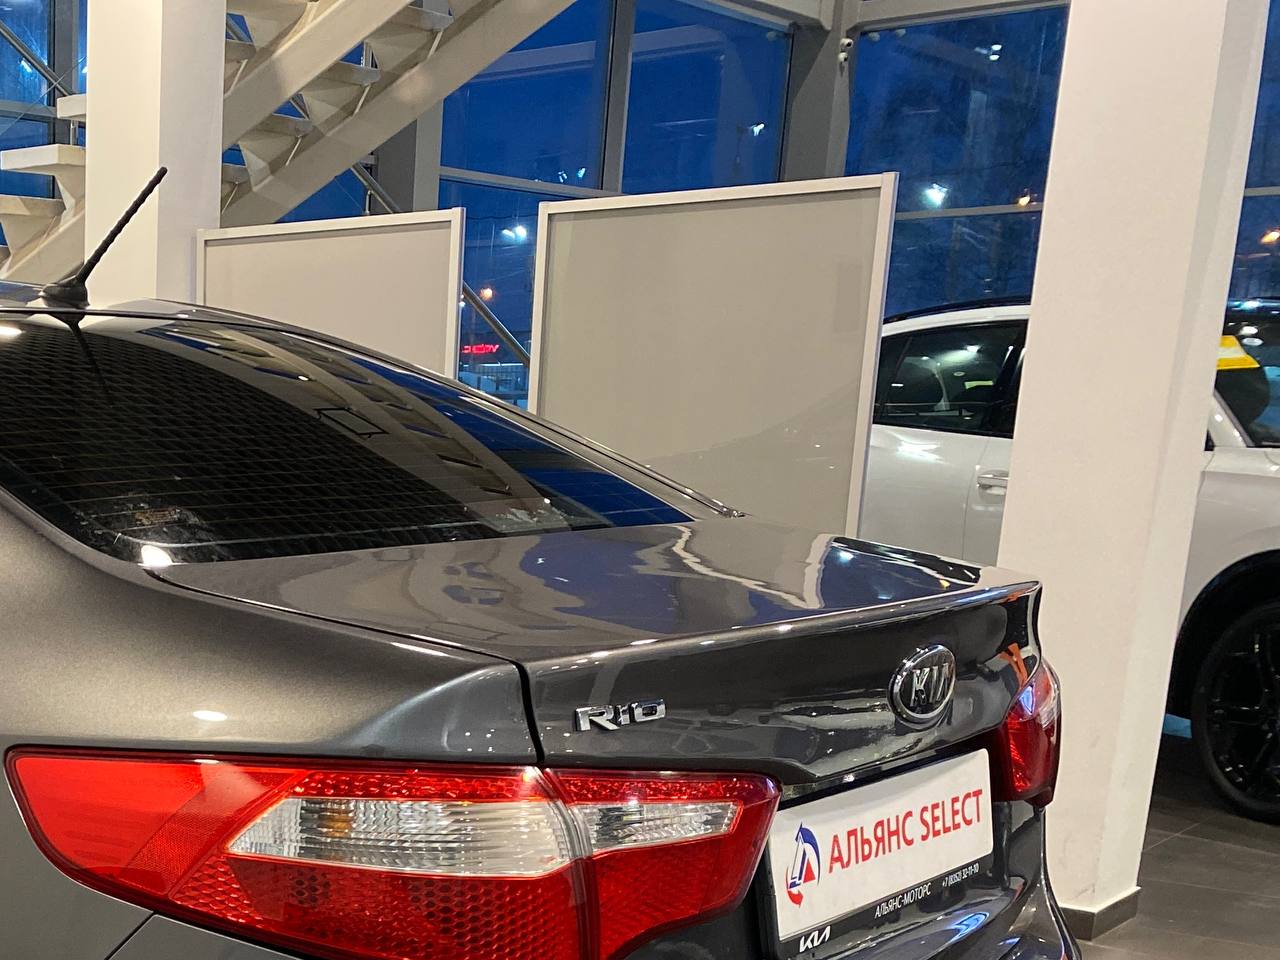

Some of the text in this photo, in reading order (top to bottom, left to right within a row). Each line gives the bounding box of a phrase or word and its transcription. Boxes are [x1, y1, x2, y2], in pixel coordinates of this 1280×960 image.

[910, 663, 950, 707] KIA
[828, 789, 982, 874] АЛЬЯНС SELECT
[874, 882, 931, 919] АЛЬЯНС-МОТОРС
[799, 925, 831, 953] KIA
